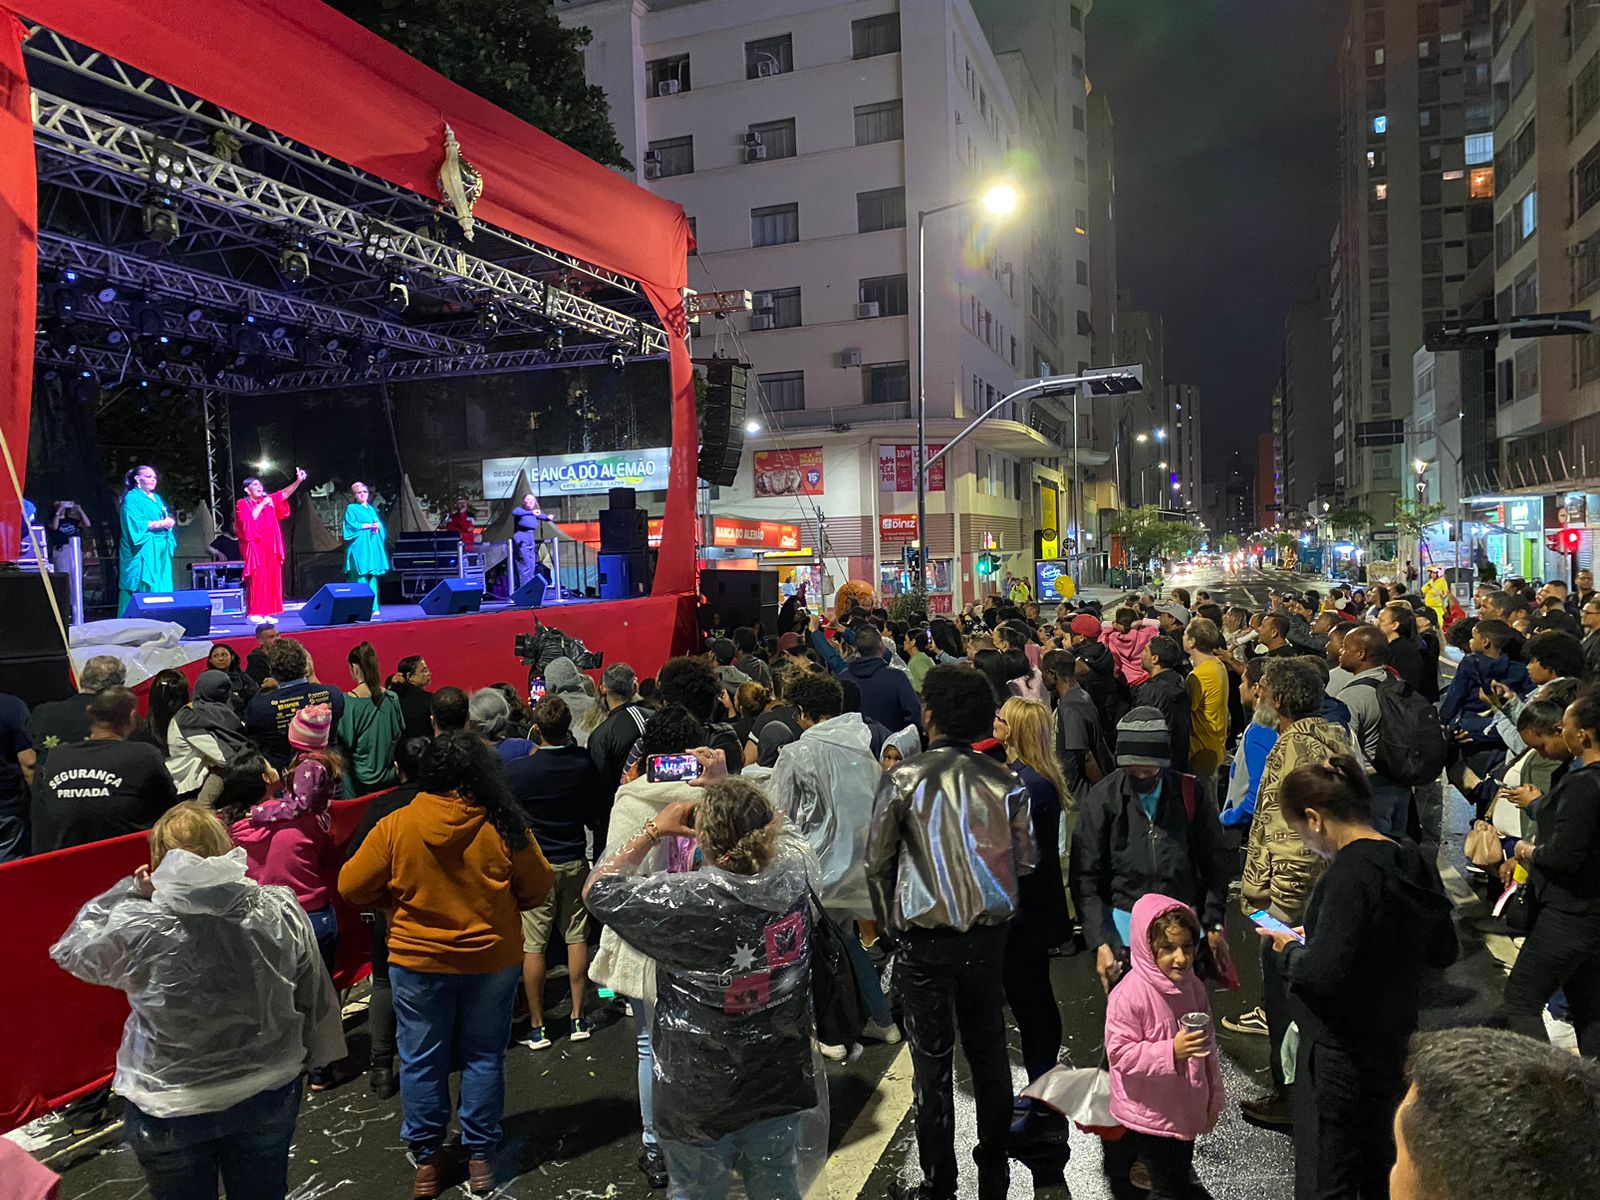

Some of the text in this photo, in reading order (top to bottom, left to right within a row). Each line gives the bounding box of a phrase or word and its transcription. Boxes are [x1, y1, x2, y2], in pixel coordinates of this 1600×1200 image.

[530, 457, 656, 482] BANCA DO ALEMÃO
[715, 527, 765, 541] BANCA DO ALEMÃO
[48, 768, 123, 790] SEGURANÇA
[57, 787, 110, 798] PRIVADA
